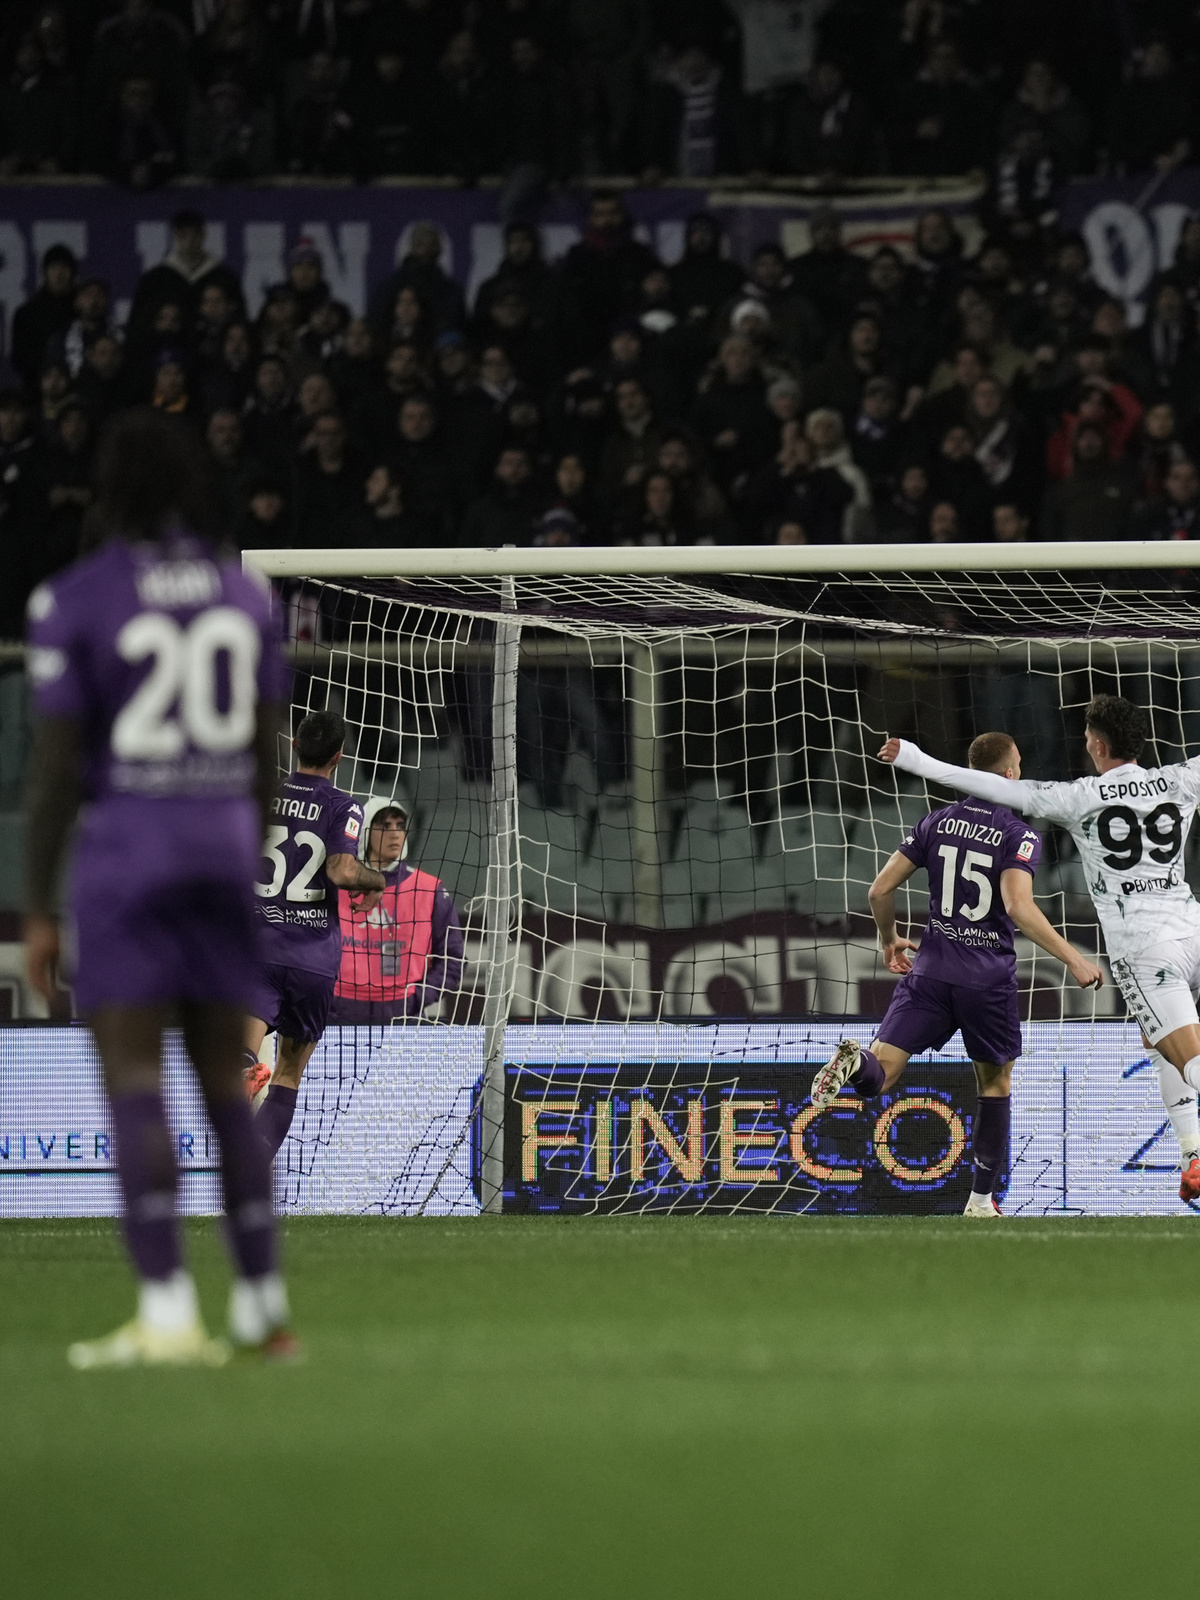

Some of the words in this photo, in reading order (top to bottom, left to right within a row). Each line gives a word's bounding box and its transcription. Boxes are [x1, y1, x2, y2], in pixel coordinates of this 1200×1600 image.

[112, 606, 260, 761] 20
[271, 798, 323, 822] ATALDI
[1099, 777, 1168, 801] ESPOSITO
[253, 825, 327, 903] 32
[937, 818, 1003, 846] COMUZZO
[1098, 803, 1183, 870] 99
[938, 844, 993, 922] 15
[342, 936, 406, 950] Mediam
[522, 1098, 967, 1181] FINECO
